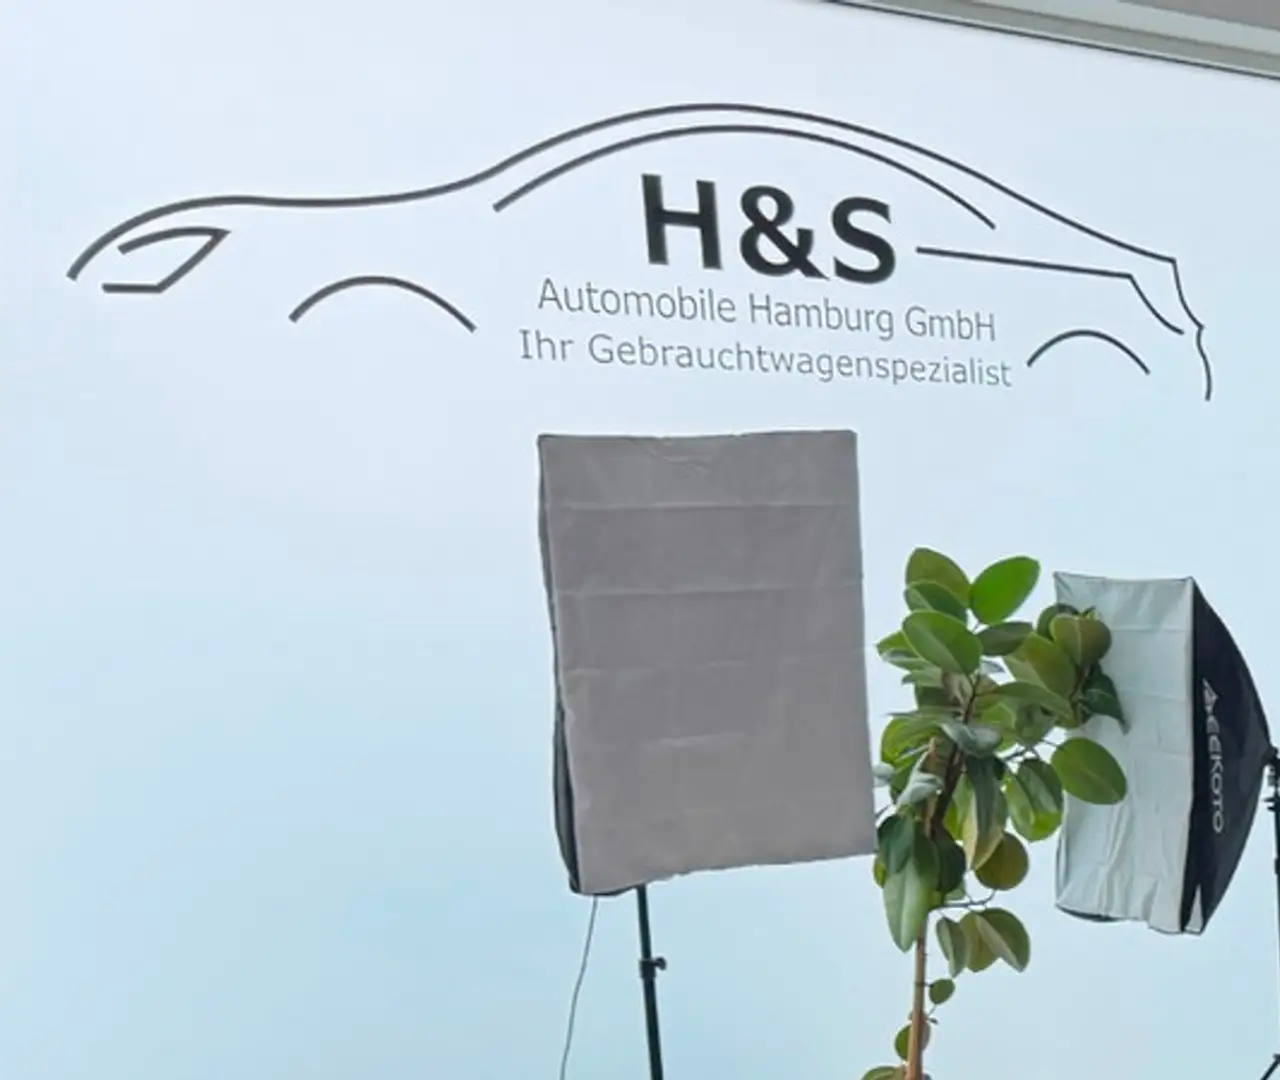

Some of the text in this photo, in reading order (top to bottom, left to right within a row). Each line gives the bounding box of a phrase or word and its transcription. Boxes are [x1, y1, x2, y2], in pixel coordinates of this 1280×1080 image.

[641, 173, 897, 284] H&S
[537, 277, 996, 342] Automobile Hamburg GmbH
[519, 329, 1012, 387] Ihr Gebrauchtwagenspezialist
